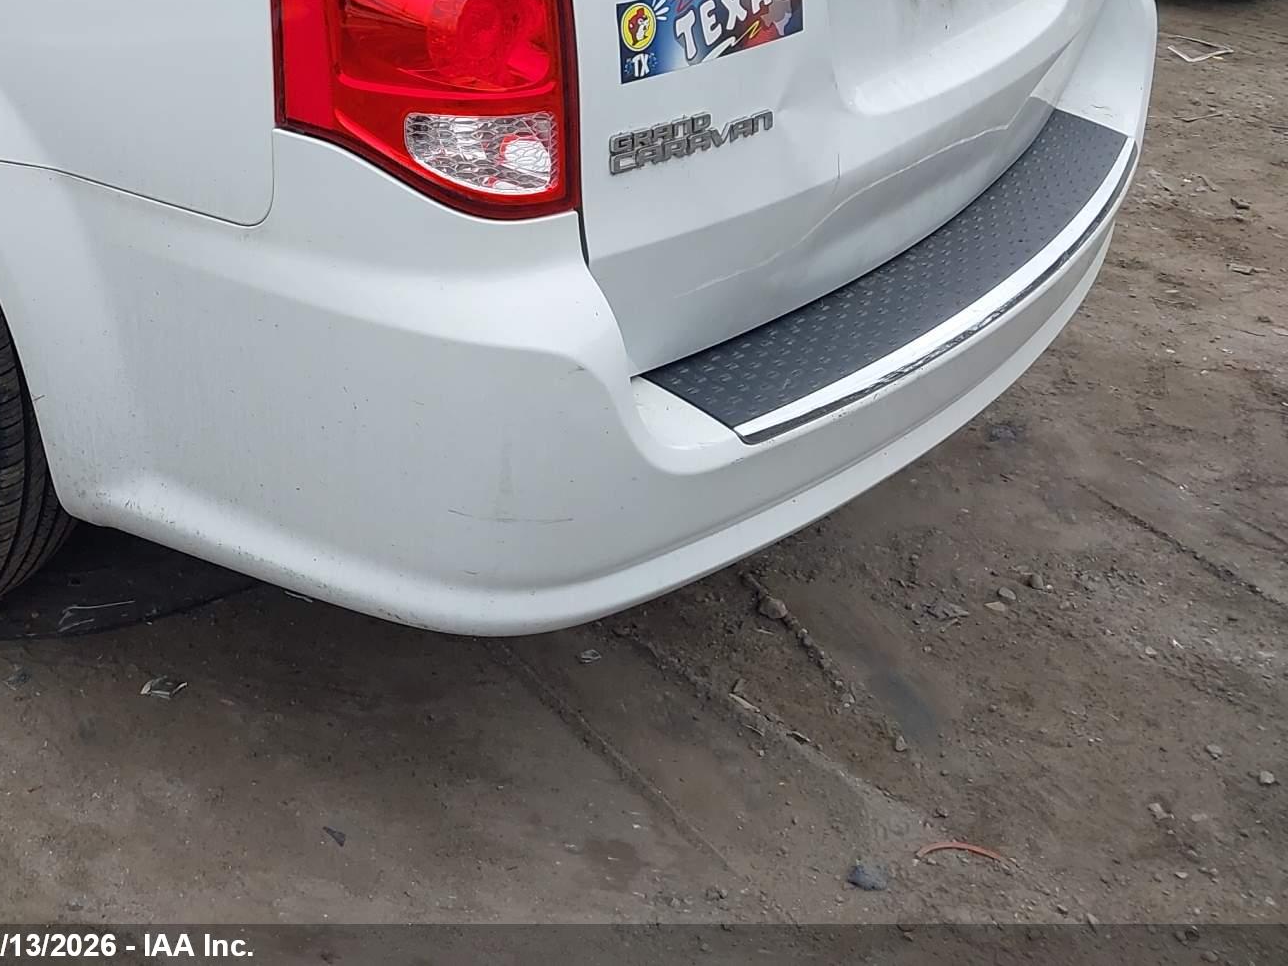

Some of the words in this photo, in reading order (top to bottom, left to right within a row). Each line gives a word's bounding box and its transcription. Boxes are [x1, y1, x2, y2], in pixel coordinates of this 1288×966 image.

[631, 53, 650, 77] TX
[609, 112, 712, 154] GRAND
[609, 109, 774, 175] CARAVAN
